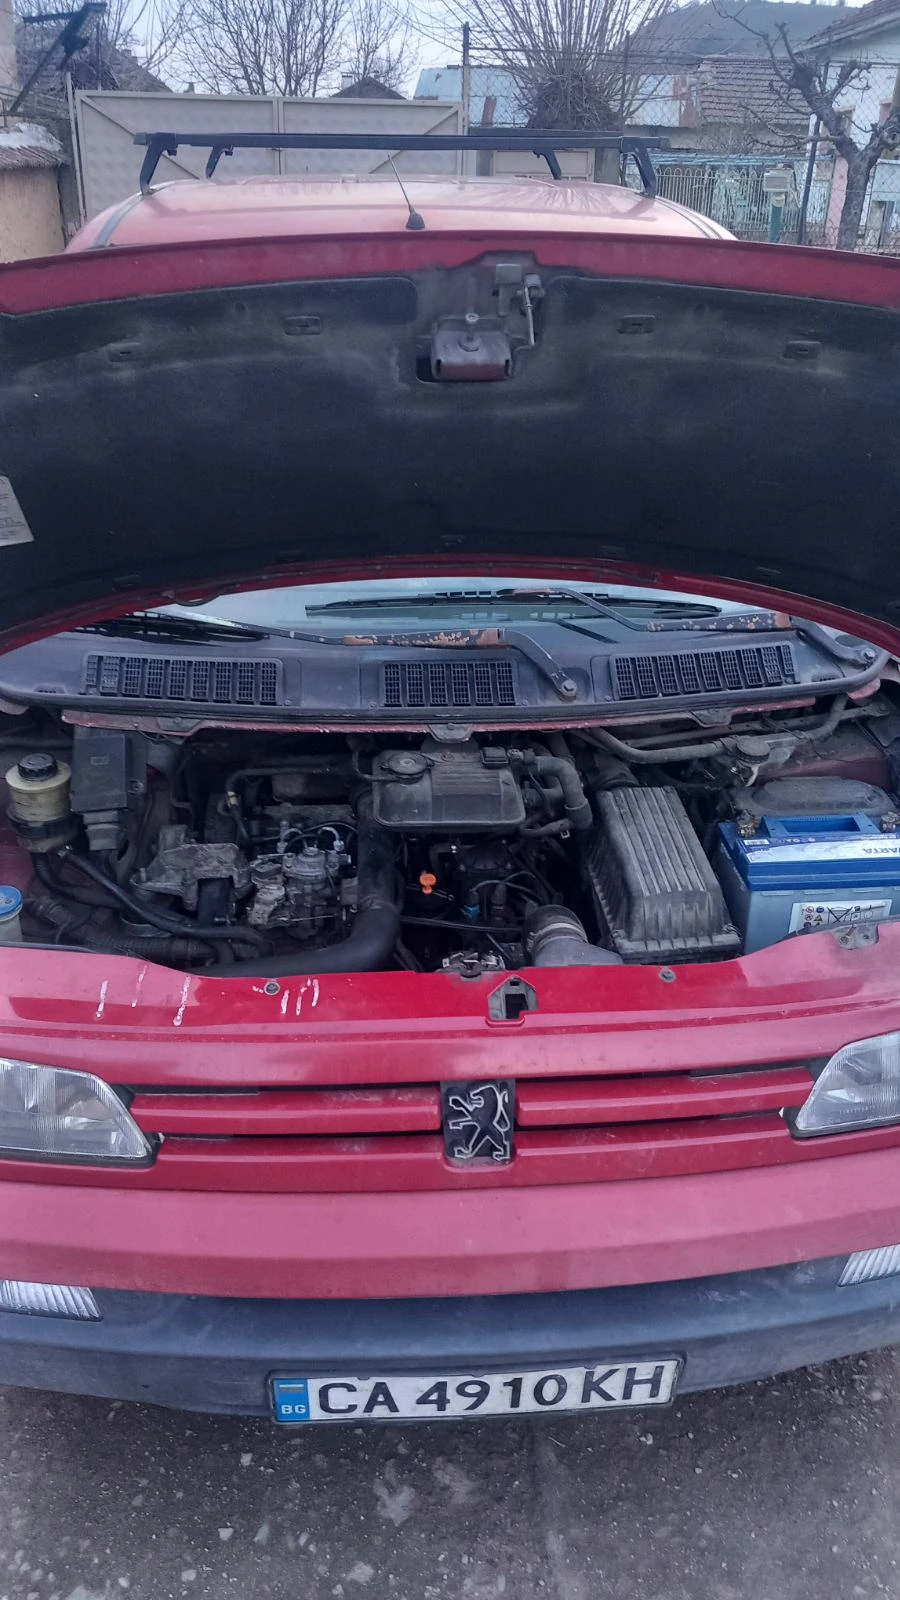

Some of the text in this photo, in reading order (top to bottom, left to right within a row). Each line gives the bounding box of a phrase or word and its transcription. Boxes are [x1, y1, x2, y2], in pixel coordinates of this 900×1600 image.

[318, 1365, 665, 1414] CA 4910 KH
[281, 1404, 306, 1415] BG
